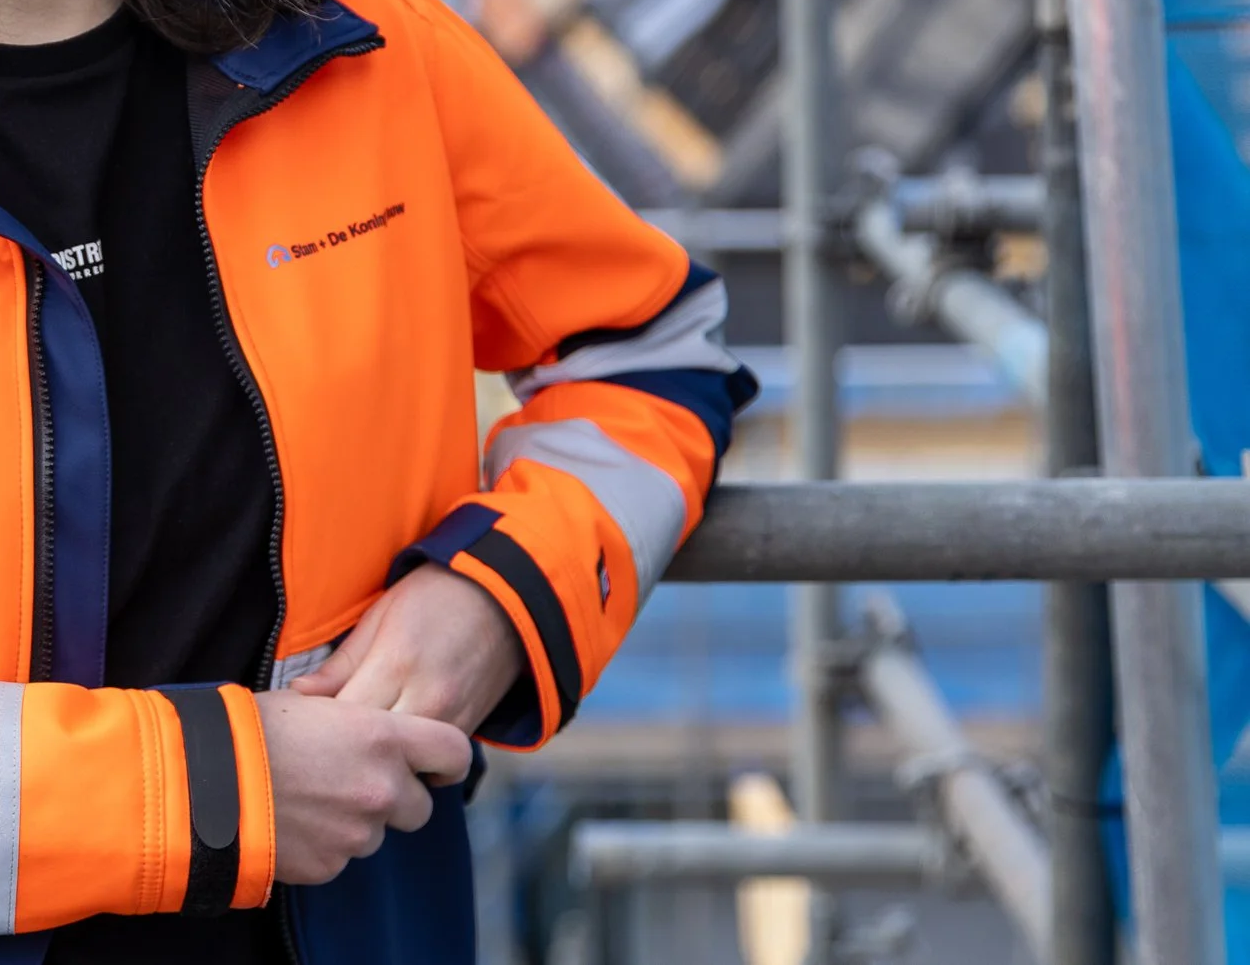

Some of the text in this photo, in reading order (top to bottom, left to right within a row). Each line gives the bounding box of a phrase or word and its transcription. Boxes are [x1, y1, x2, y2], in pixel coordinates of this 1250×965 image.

[291, 243, 319, 259] Stam
[319, 240, 326, 248] +
[327, 231, 348, 246] De
